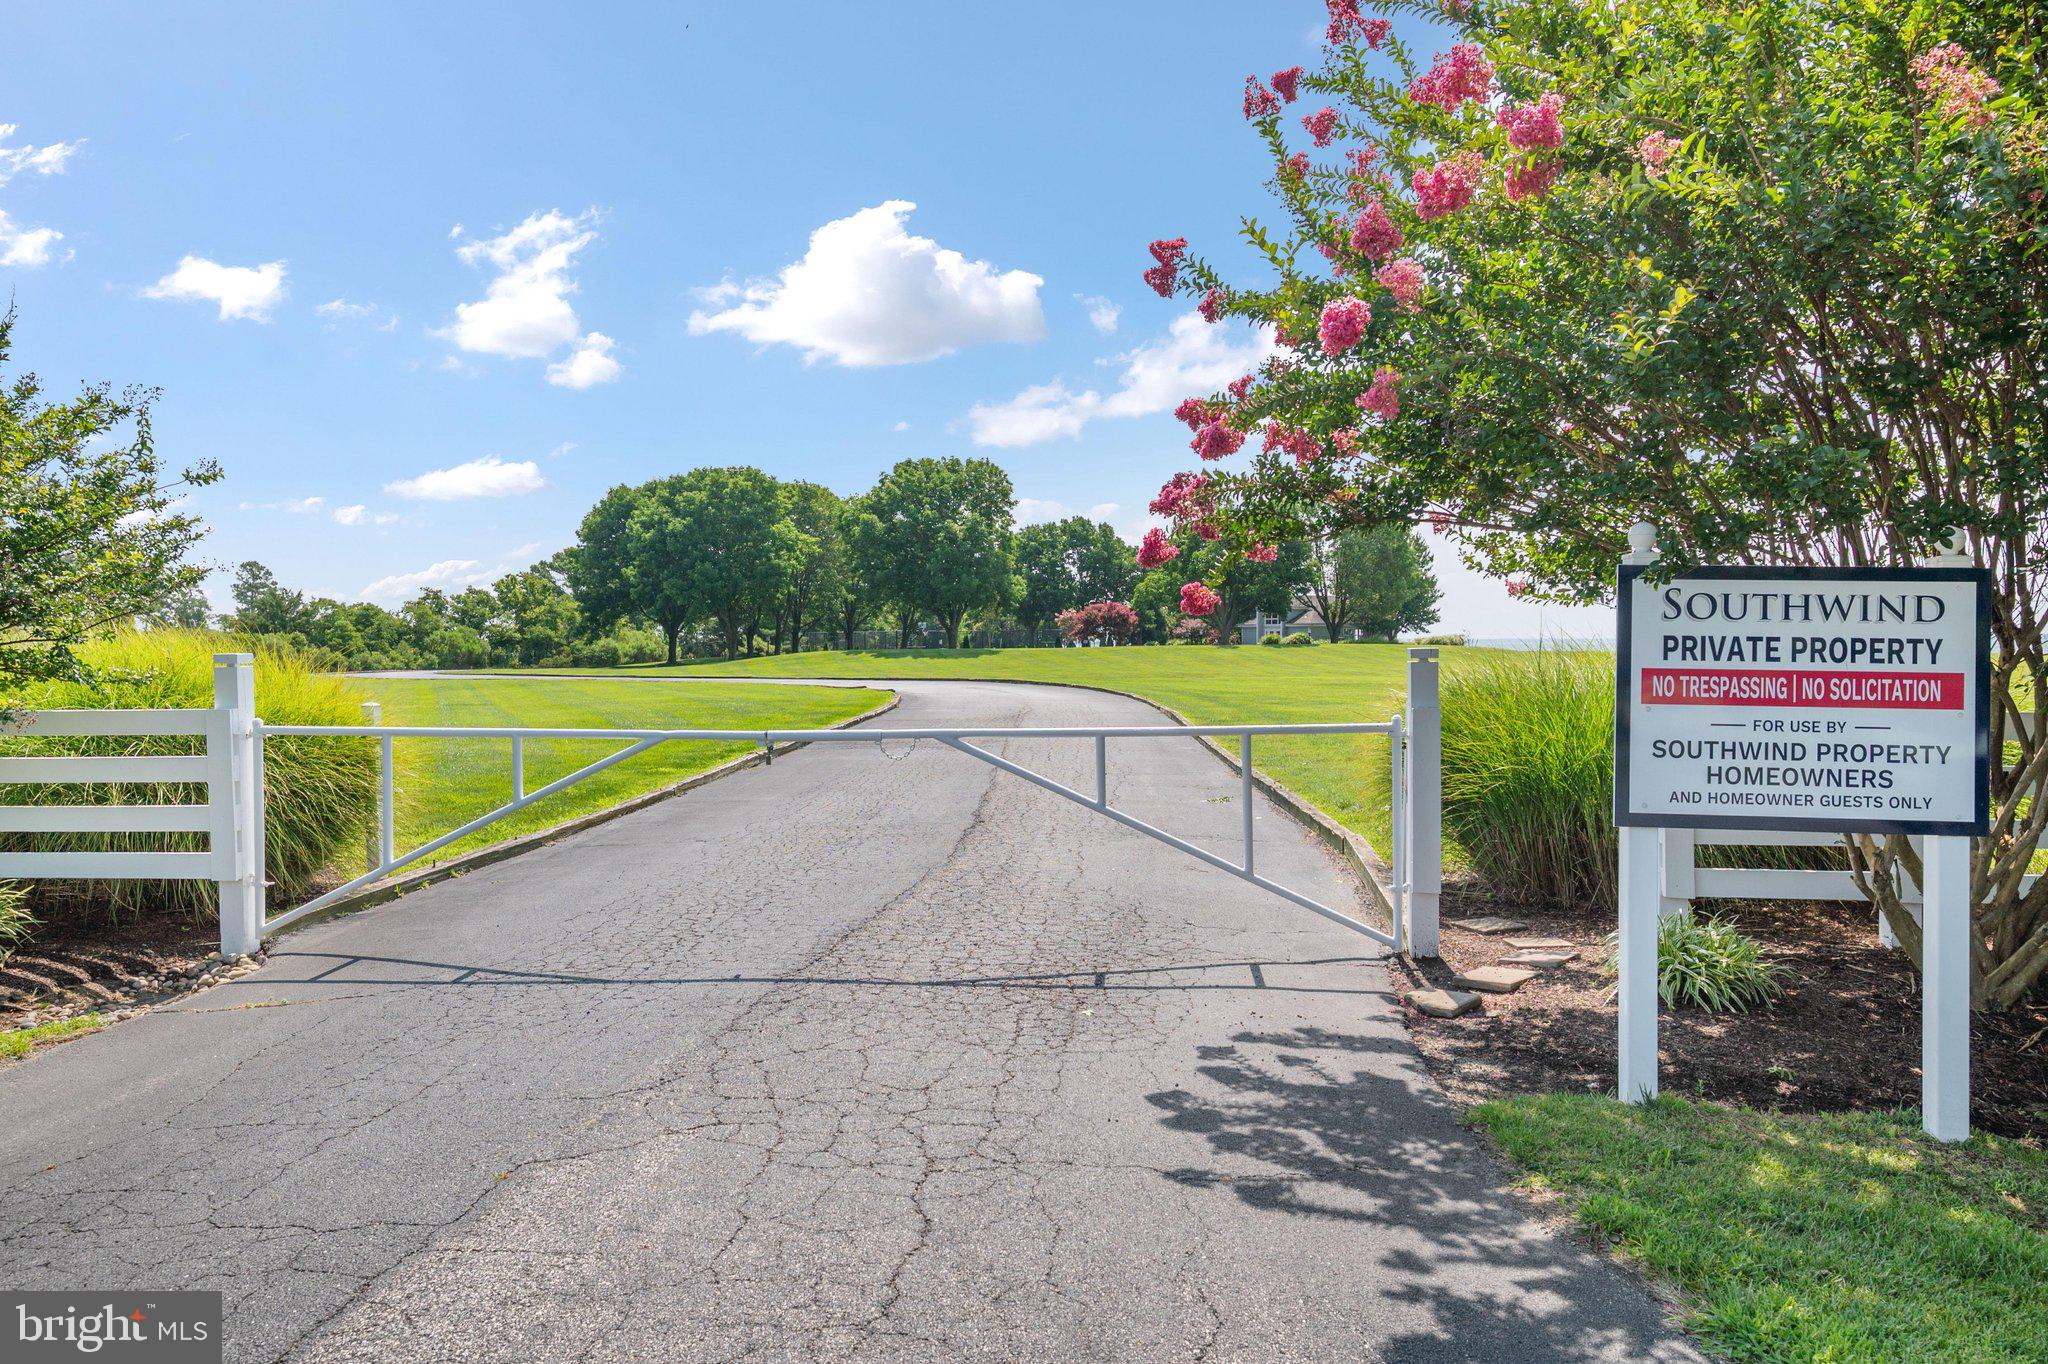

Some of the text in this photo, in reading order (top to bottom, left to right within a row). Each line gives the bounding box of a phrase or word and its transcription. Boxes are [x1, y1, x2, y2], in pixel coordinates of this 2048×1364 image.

[1661, 587, 1946, 624] SOUTHWIND
[1663, 635, 1944, 665] PRIVATE PROPERTY
[1652, 675, 1942, 702] NO TRESPASSING NO SOLICITATION
[1753, 719, 1847, 734] FOR USE BY
[1651, 739, 1952, 765] SOUTHWIND PROPERTY
[1706, 766, 1894, 789] HOMEOWNERS
[1669, 791, 1933, 810] AND HOMEOWNER GUESTS ONLY
